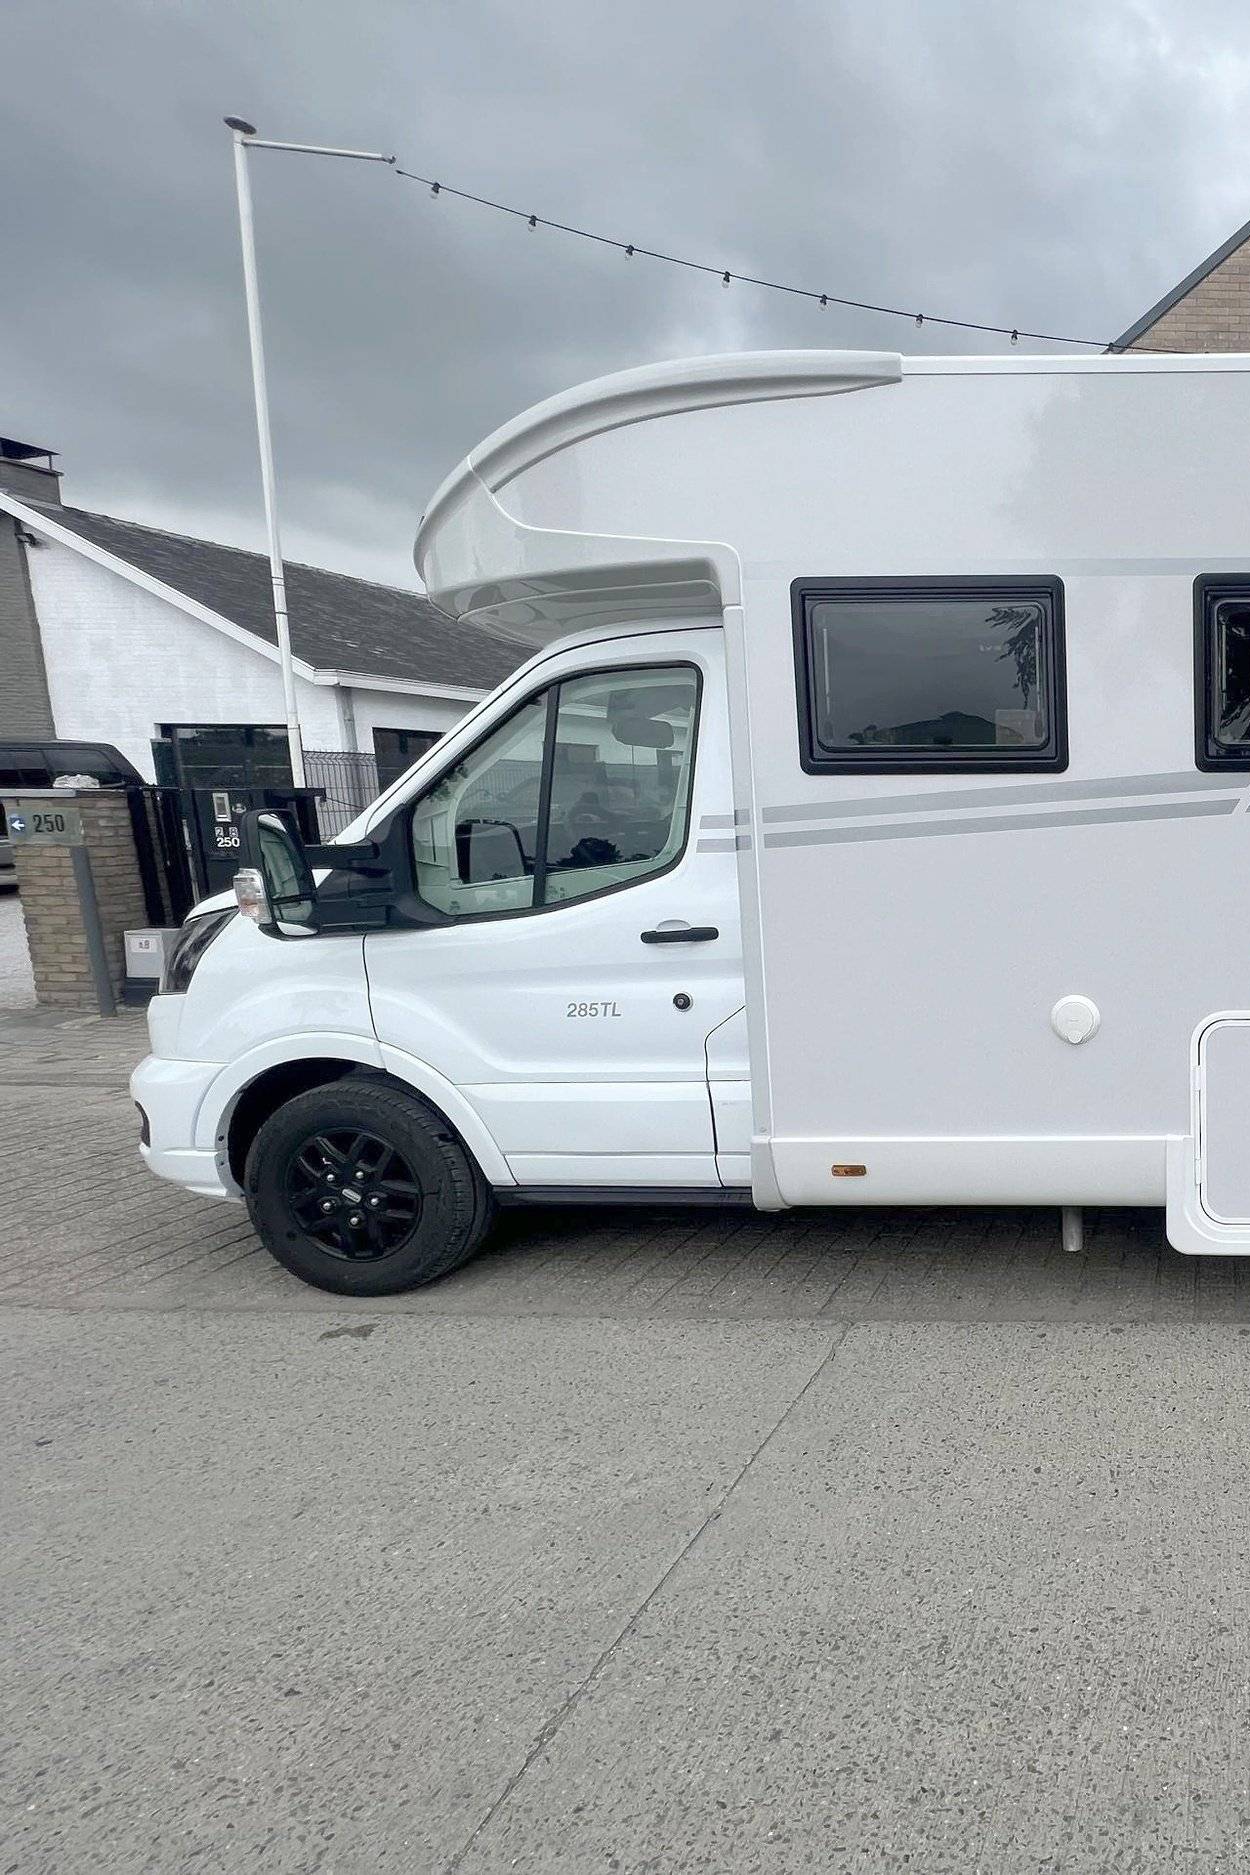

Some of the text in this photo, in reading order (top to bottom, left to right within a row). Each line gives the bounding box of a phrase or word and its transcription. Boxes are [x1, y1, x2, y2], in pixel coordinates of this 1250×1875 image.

[32, 814, 65, 833] 250
[216, 837, 240, 847] 250
[566, 1001, 622, 1018] 285TL
